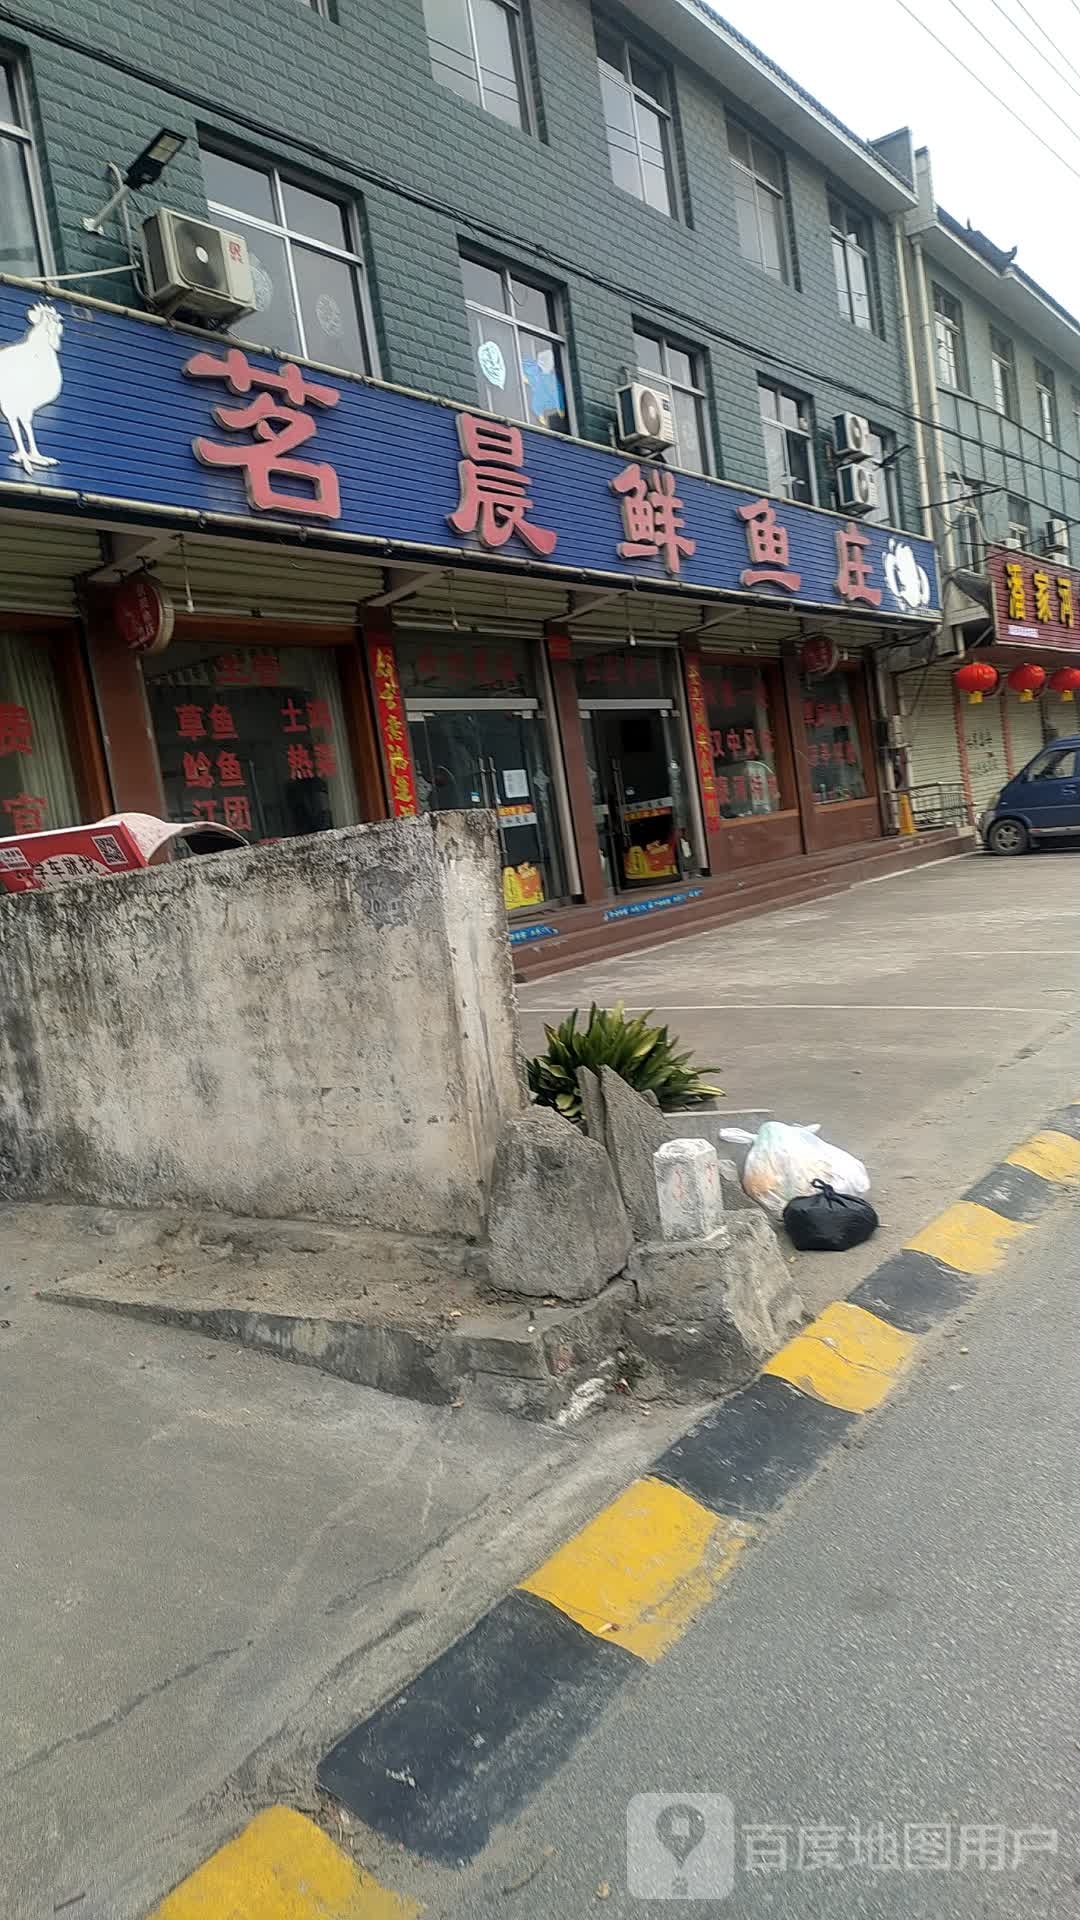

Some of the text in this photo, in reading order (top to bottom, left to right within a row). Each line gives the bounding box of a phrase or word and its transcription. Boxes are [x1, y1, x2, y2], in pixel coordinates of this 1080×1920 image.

[181, 348, 882, 606] 茗晨鲜鱼庄
[175, 703, 239, 741] 草鱼
[280, 697, 333, 734] 土鸡
[287, 743, 337, 780] 热菜
[191, 796, 250, 832] 江团
